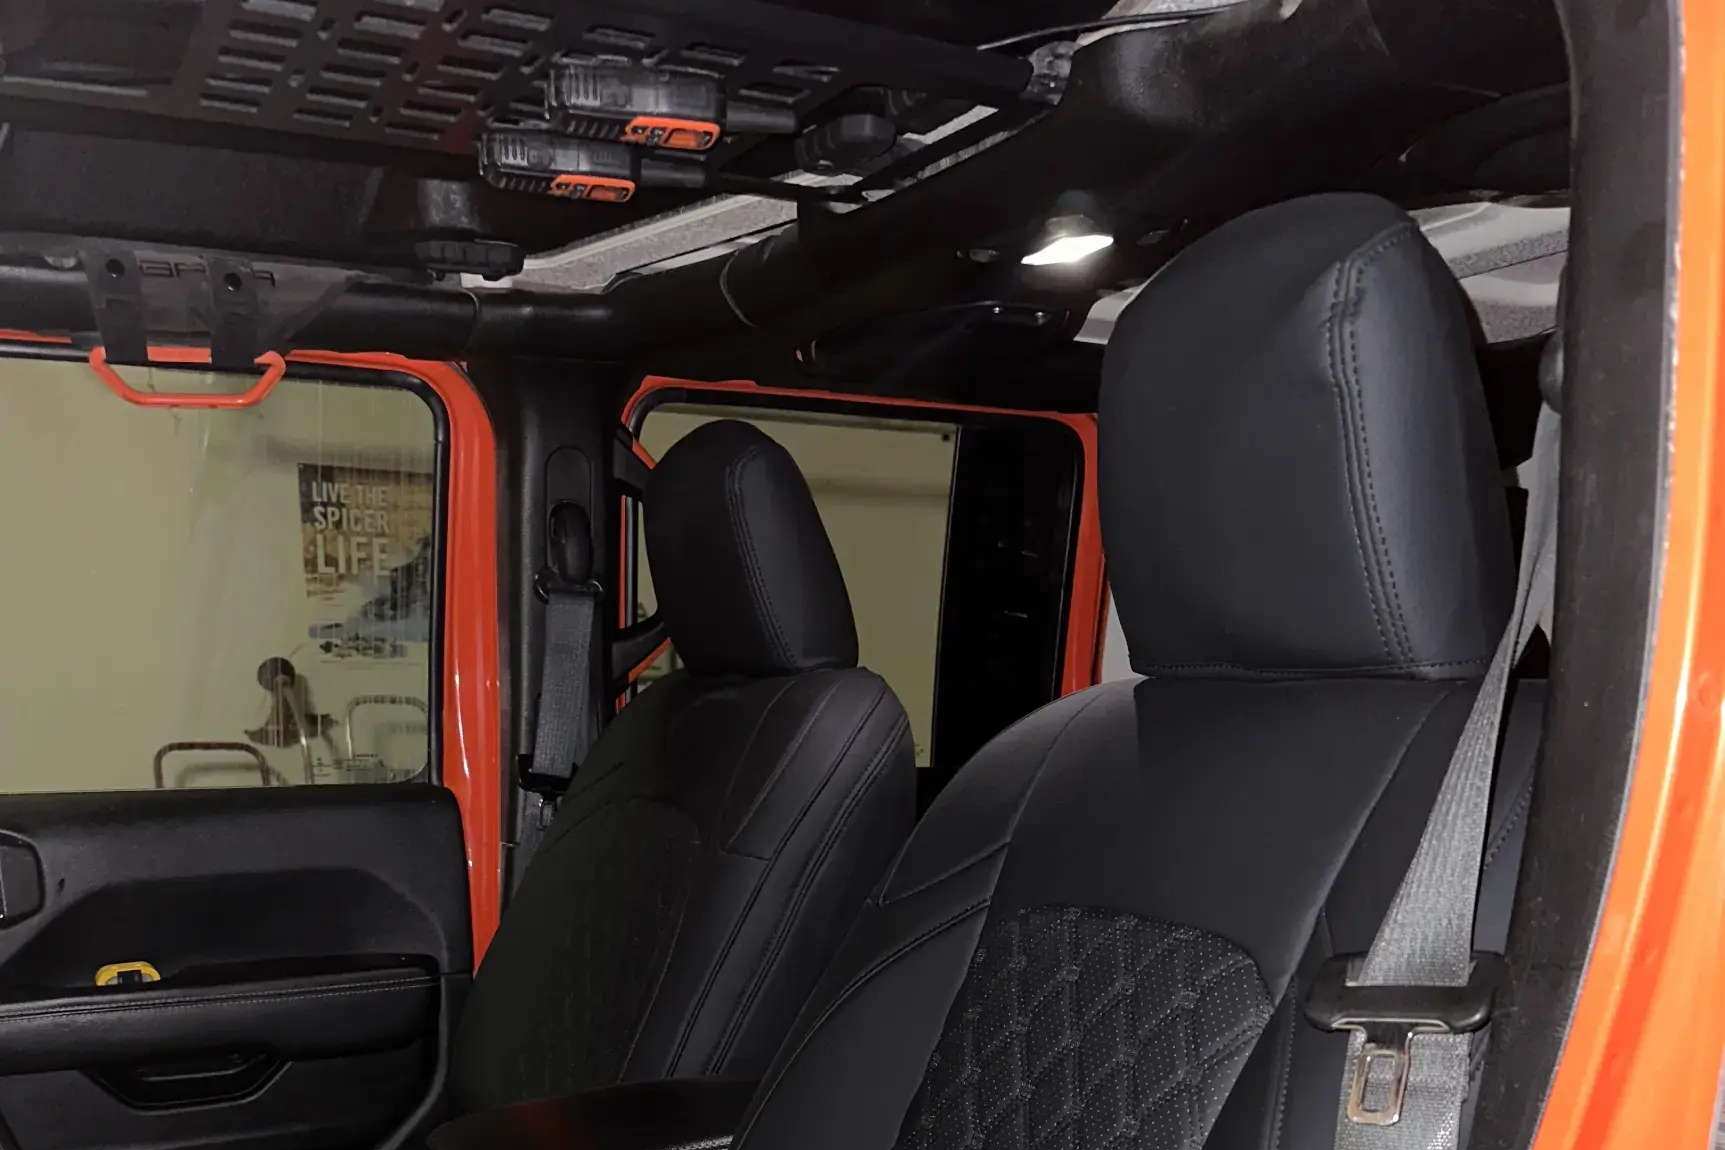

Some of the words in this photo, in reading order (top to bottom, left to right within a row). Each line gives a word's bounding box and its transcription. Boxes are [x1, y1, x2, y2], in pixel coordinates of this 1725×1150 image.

[312, 481, 350, 503] LIVE
[356, 484, 389, 507] THE
[313, 506, 390, 533] SPICER
[316, 533, 391, 576] LIFE
